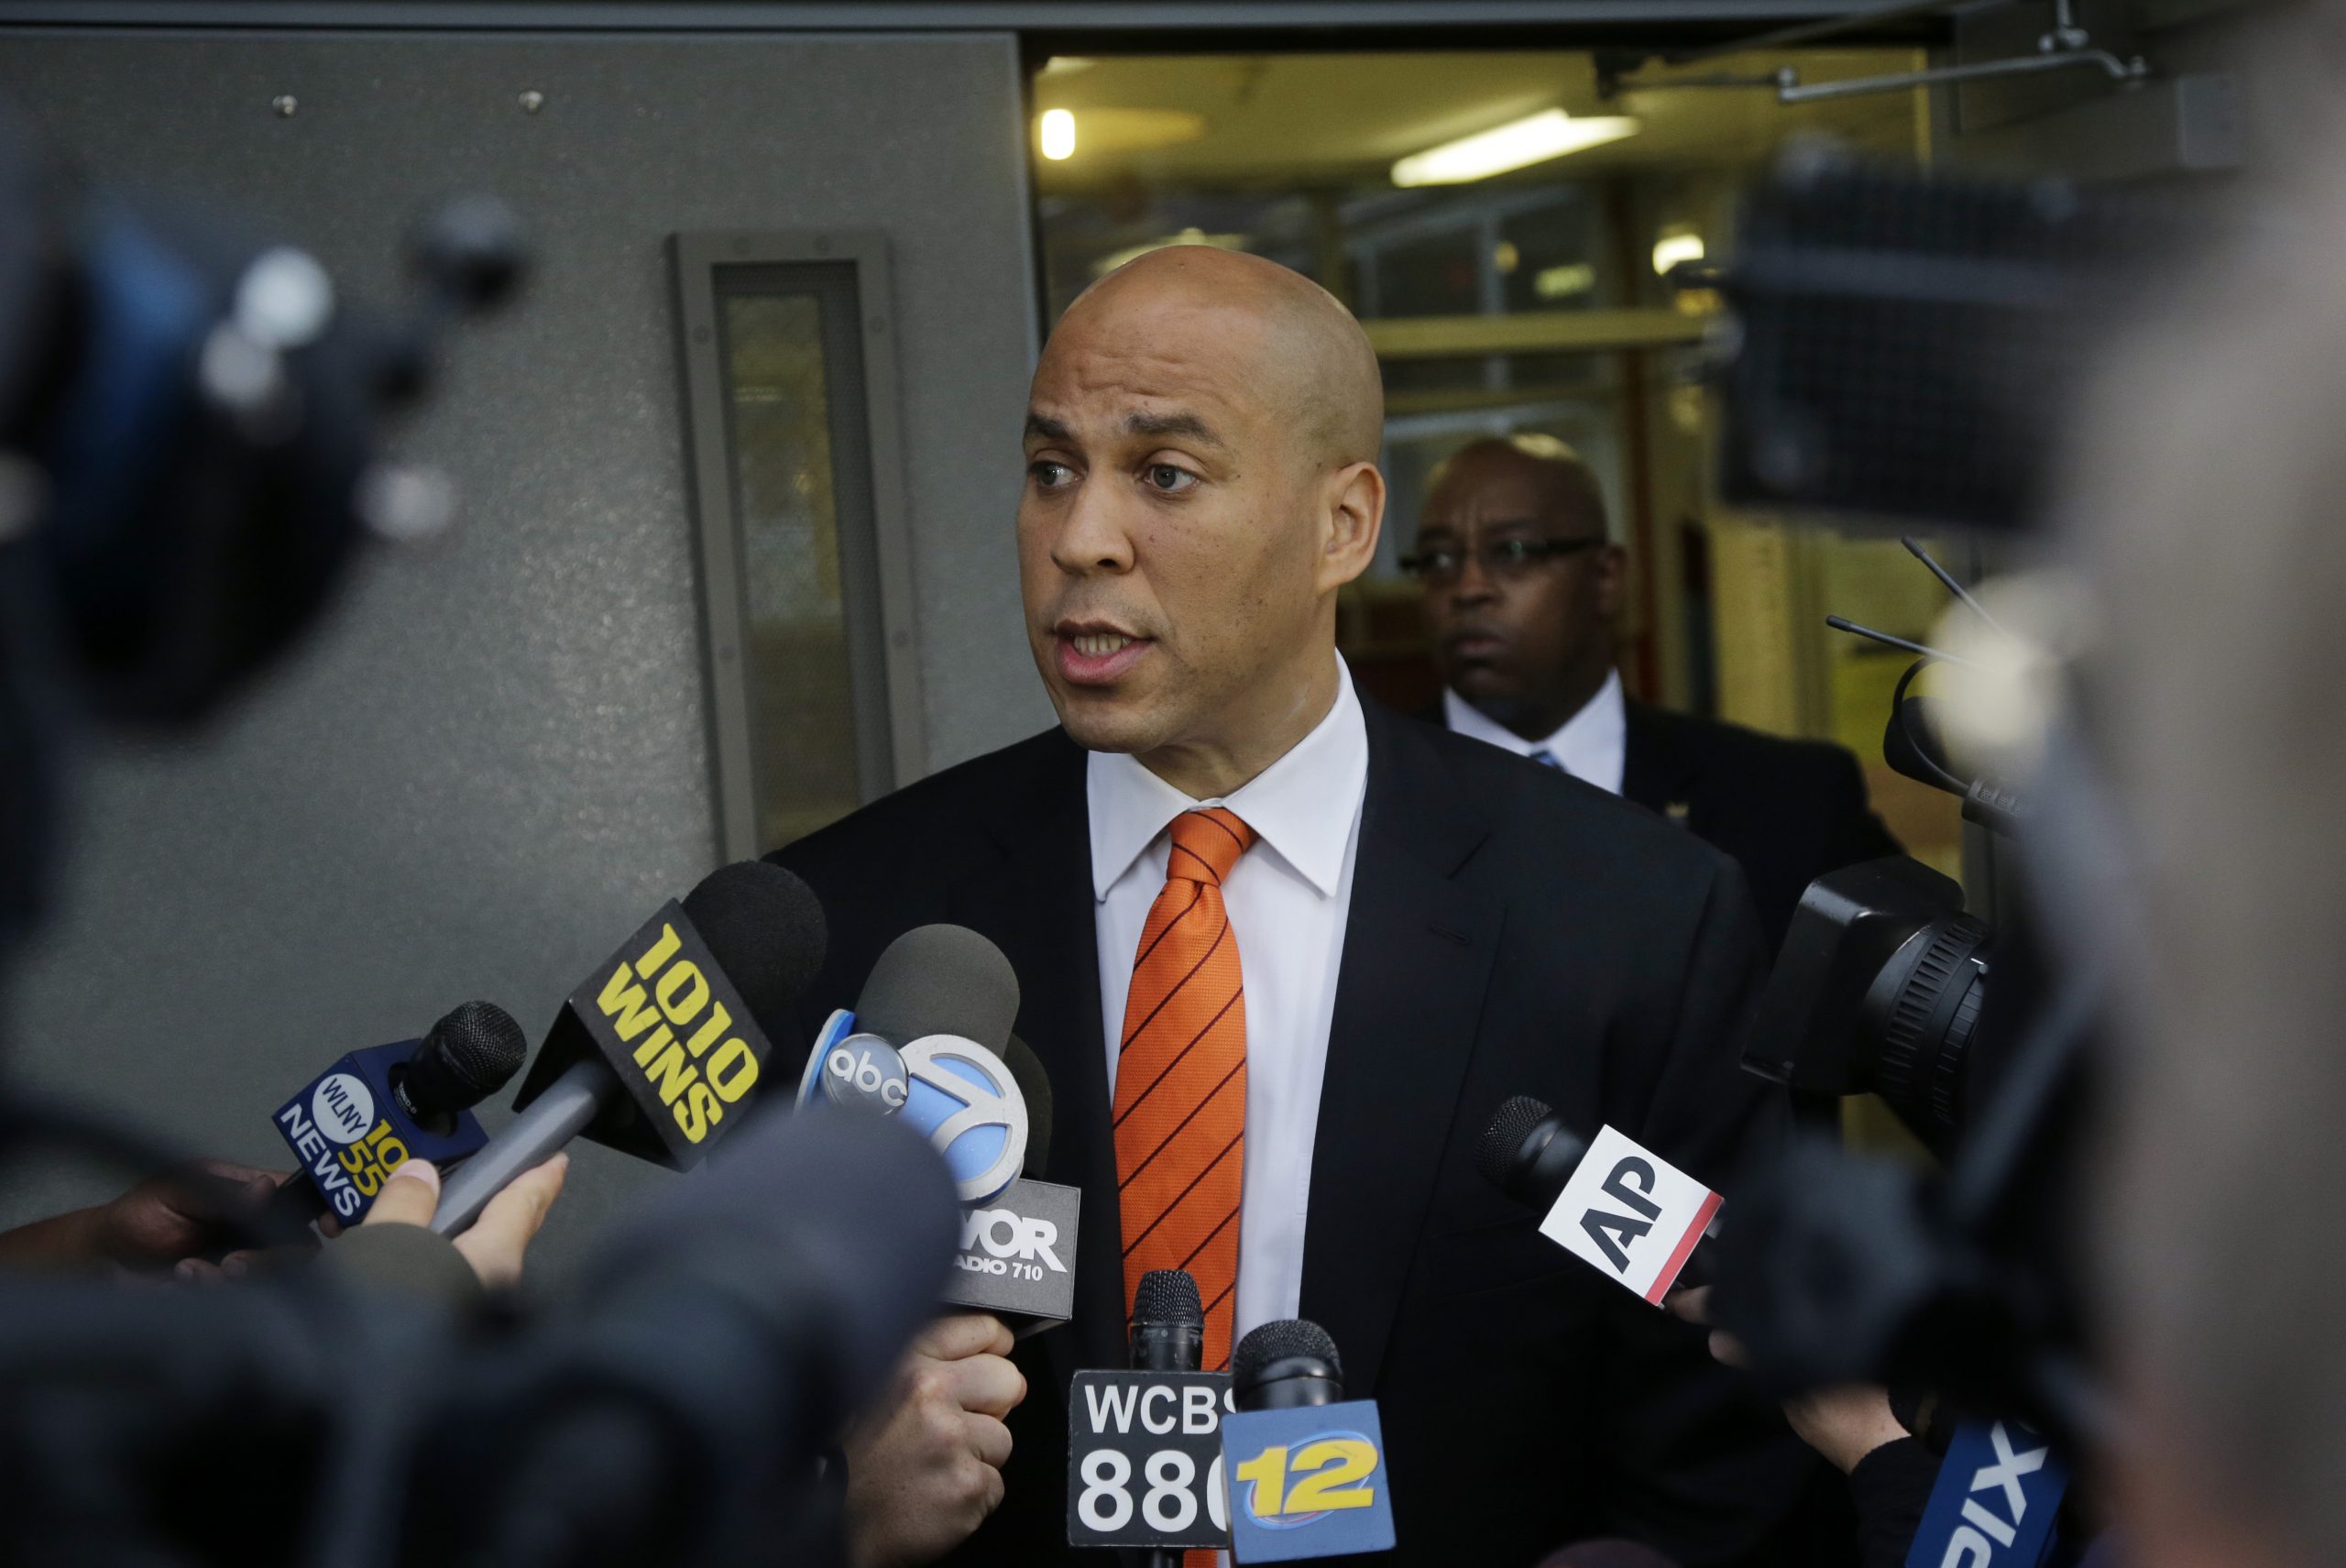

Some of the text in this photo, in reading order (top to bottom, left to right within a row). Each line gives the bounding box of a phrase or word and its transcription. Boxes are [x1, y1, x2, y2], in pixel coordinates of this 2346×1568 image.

[635, 923, 759, 1102] 1010
[597, 961, 723, 1144] WINS
[828, 1049, 907, 1106] abc
[323, 1078, 367, 1135] WLNY
[280, 1103, 361, 1217] NEWS
[338, 1140, 389, 1197] 55
[366, 1118, 410, 1177] 10
[1579, 1156, 1662, 1275] AP
[954, 1255, 1043, 1281] ADIO 710
[1084, 1385, 1236, 1434] WCB
[1237, 1439, 1378, 1518] 12
